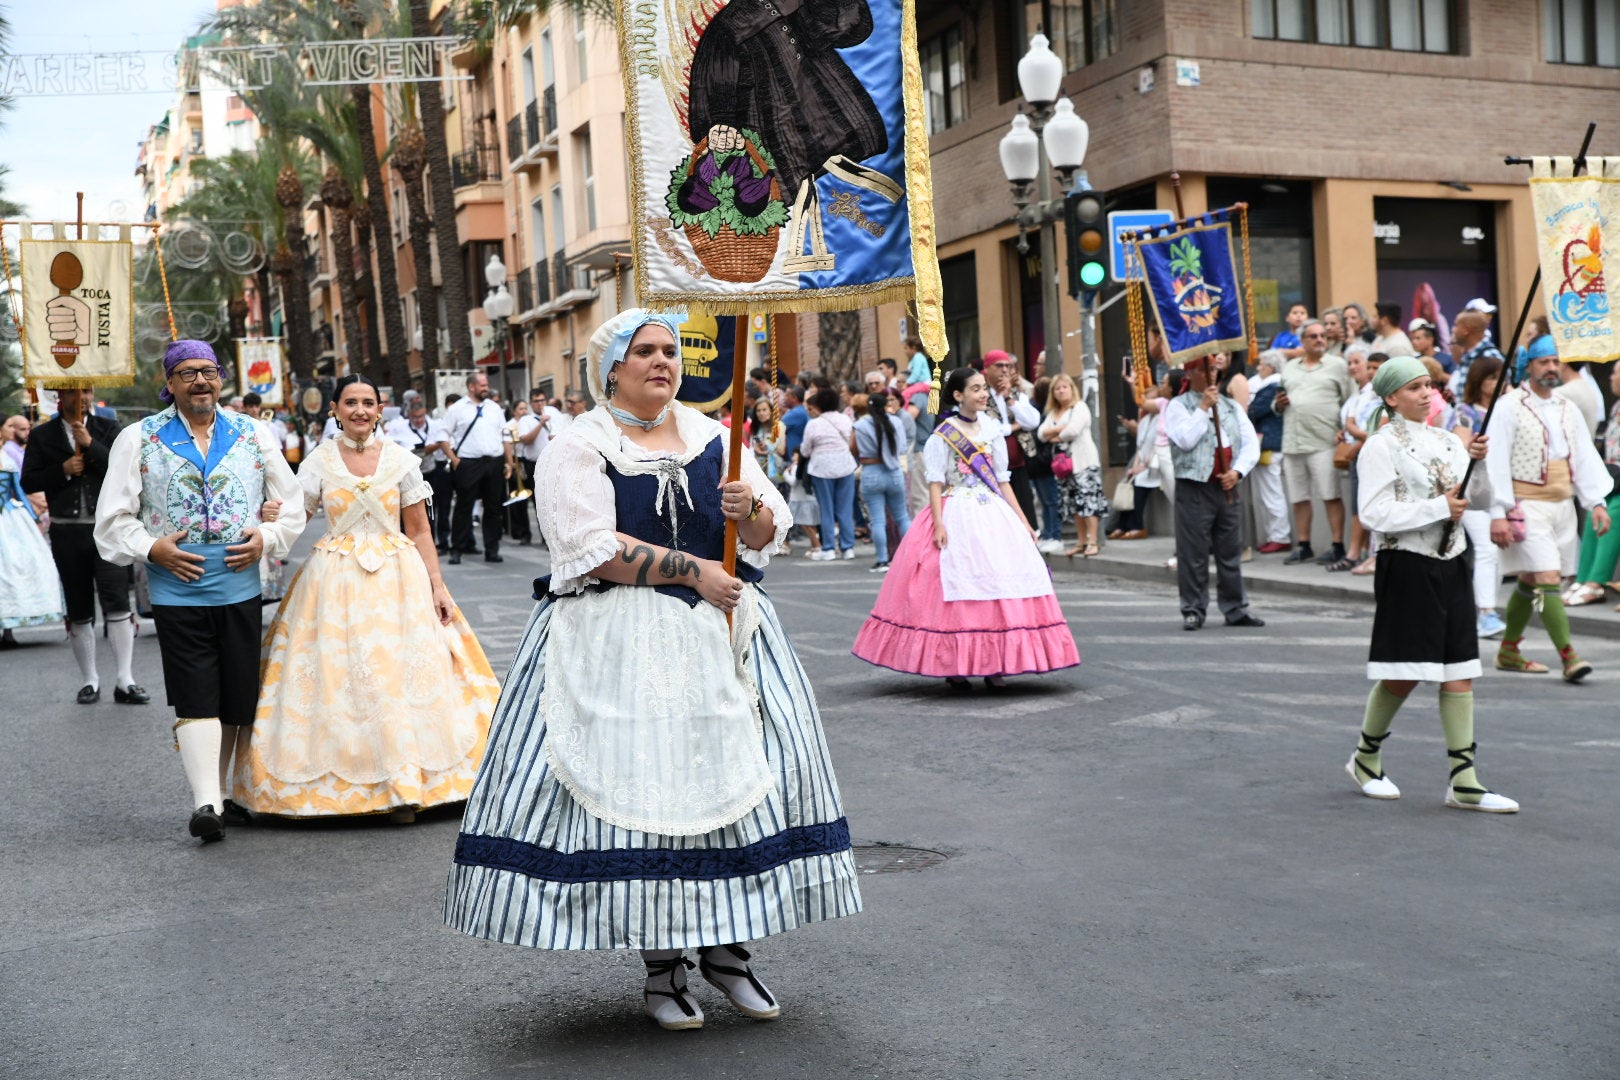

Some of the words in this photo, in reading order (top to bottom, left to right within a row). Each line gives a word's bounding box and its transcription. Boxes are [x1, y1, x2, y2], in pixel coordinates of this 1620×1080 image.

[633, 0, 660, 79] BARRA
[0, 54, 149, 94] ARRER
[163, 48, 279, 90] SANT
[306, 41, 460, 80] VICENT
[81, 289, 111, 299] TOCA
[98, 301, 111, 348] FUSTA
